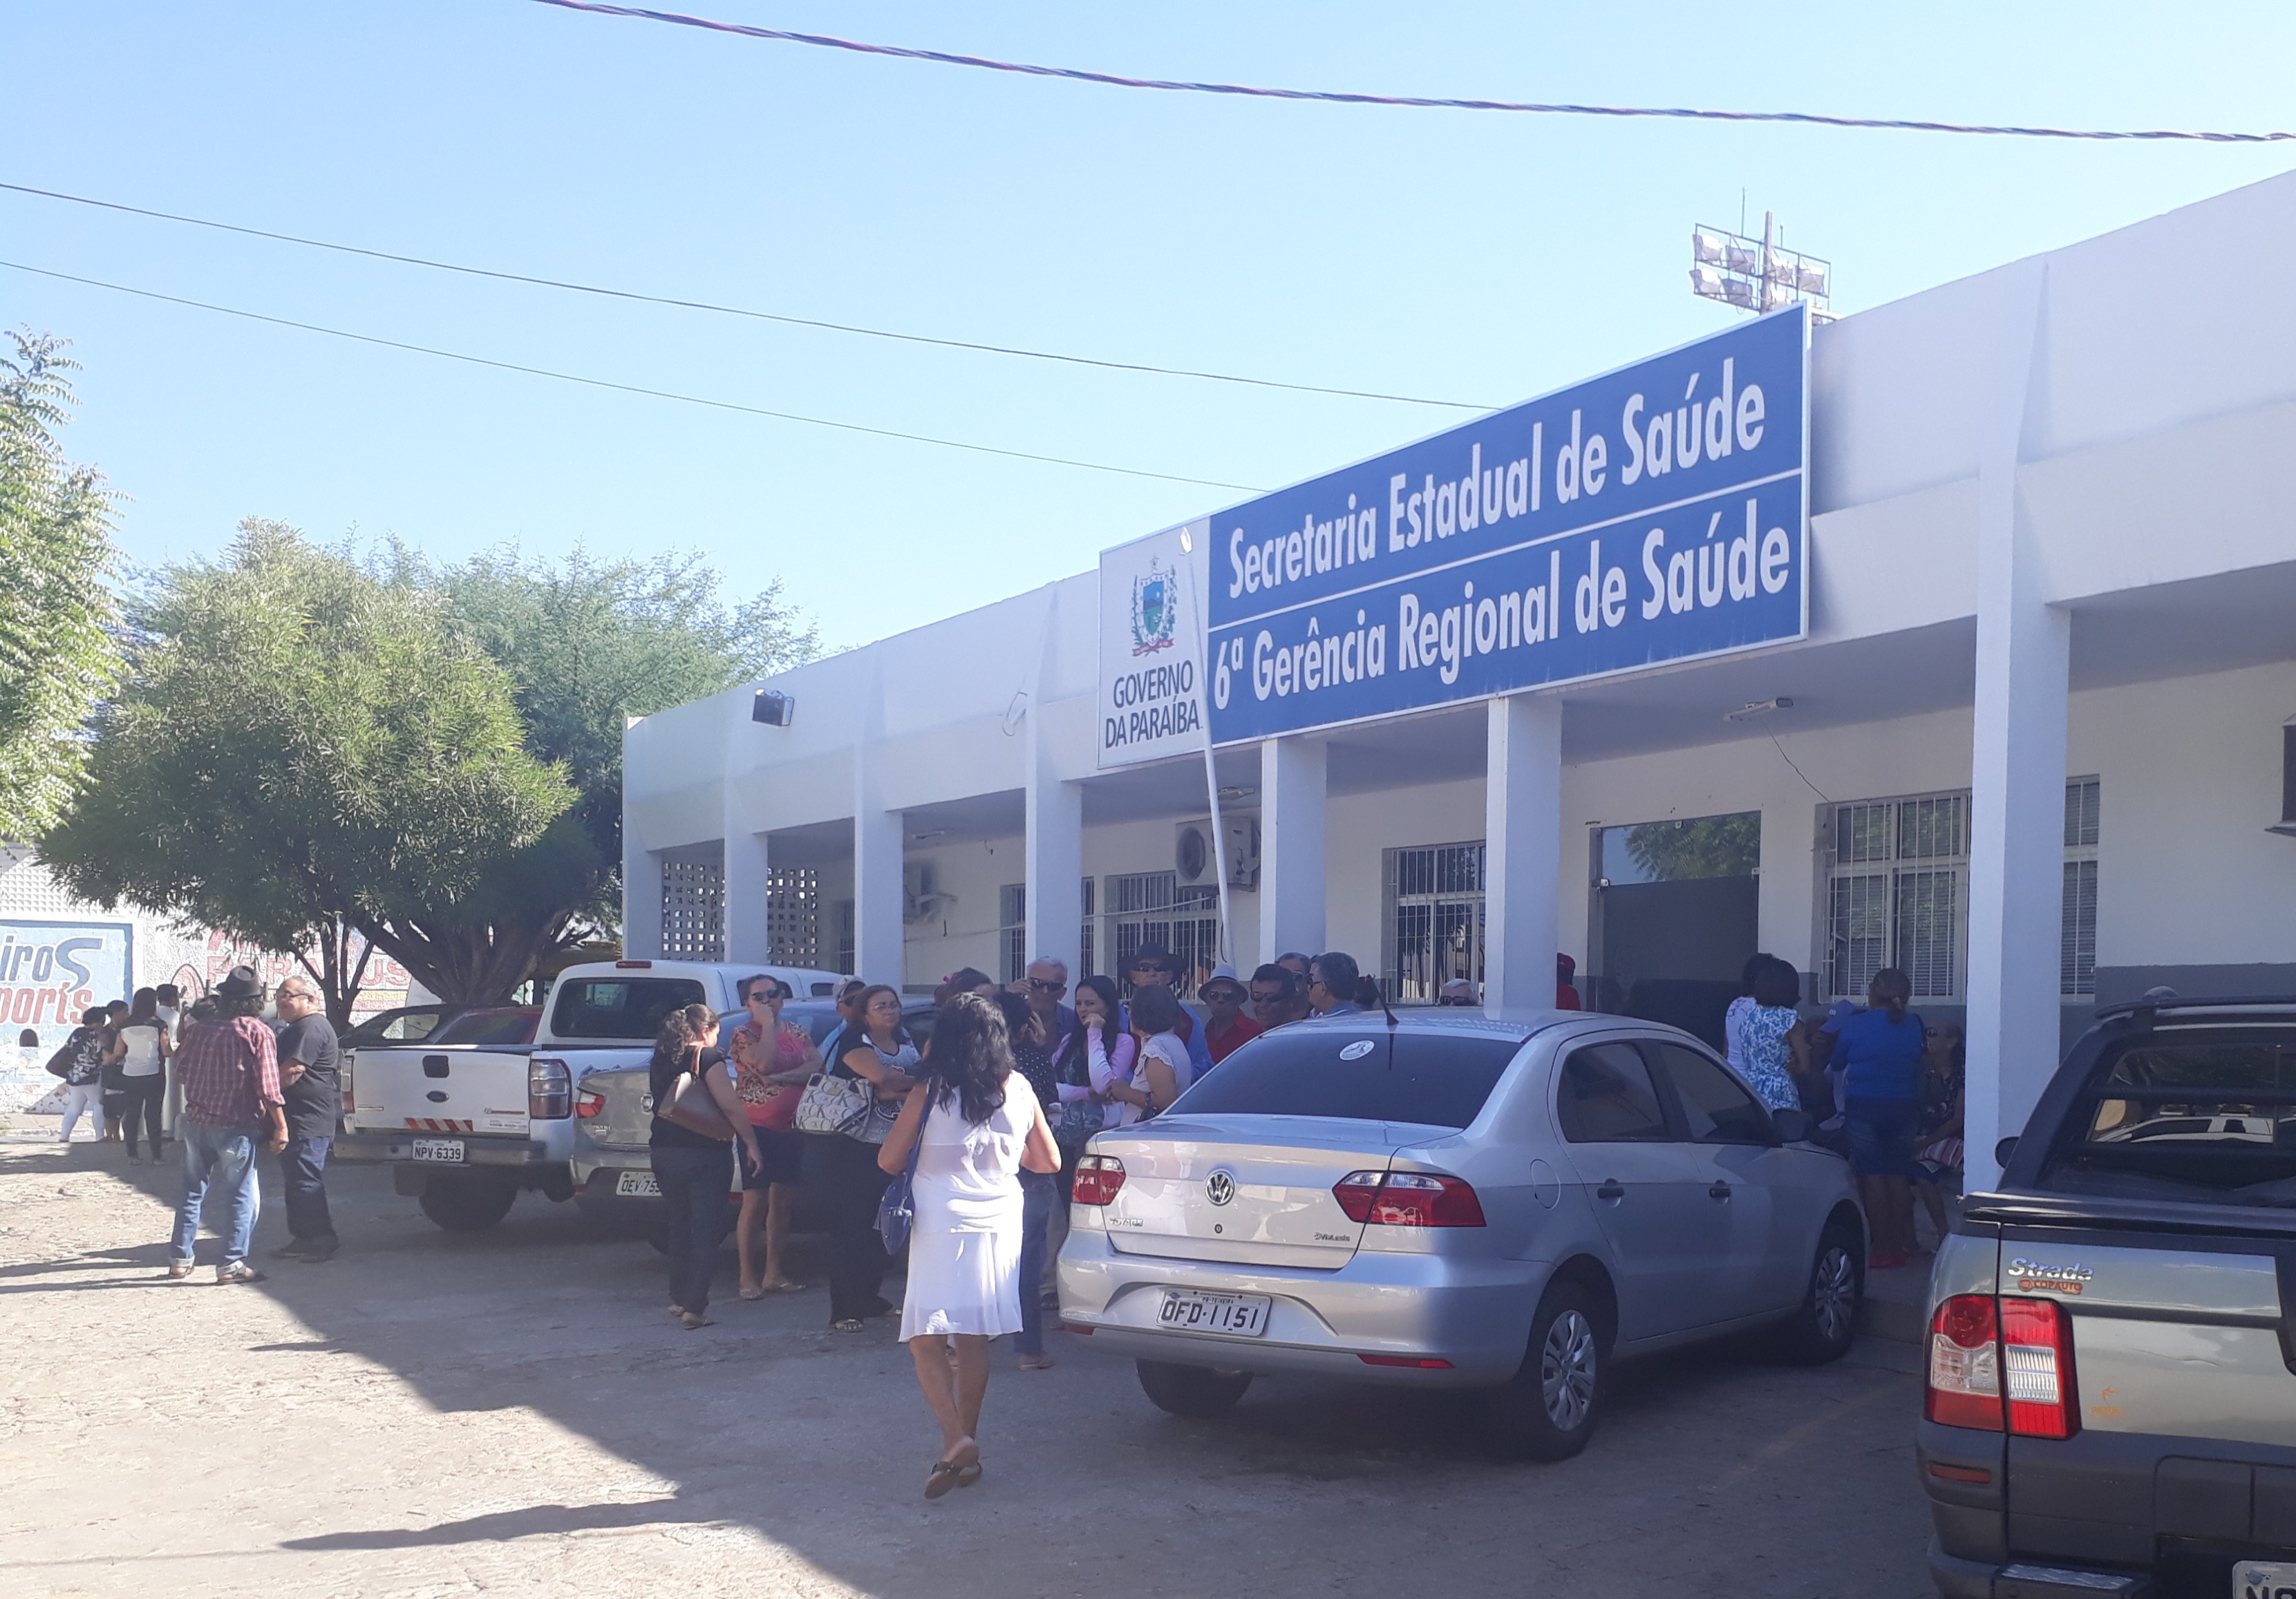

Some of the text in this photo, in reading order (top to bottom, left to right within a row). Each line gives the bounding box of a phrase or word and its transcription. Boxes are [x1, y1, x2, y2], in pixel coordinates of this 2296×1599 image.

[1230, 357, 1765, 598] Secretaria Estadual de Saúde
[1252, 609, 1386, 701] Gerência
[1398, 550, 1560, 685] Regional
[1574, 540, 1627, 634] de
[1642, 498, 1790, 620] Saúde
[1113, 660, 1194, 709] GOVERNO
[1107, 694, 1201, 749] DA PARAÍBA
[2008, 1257, 2094, 1281] Strada
